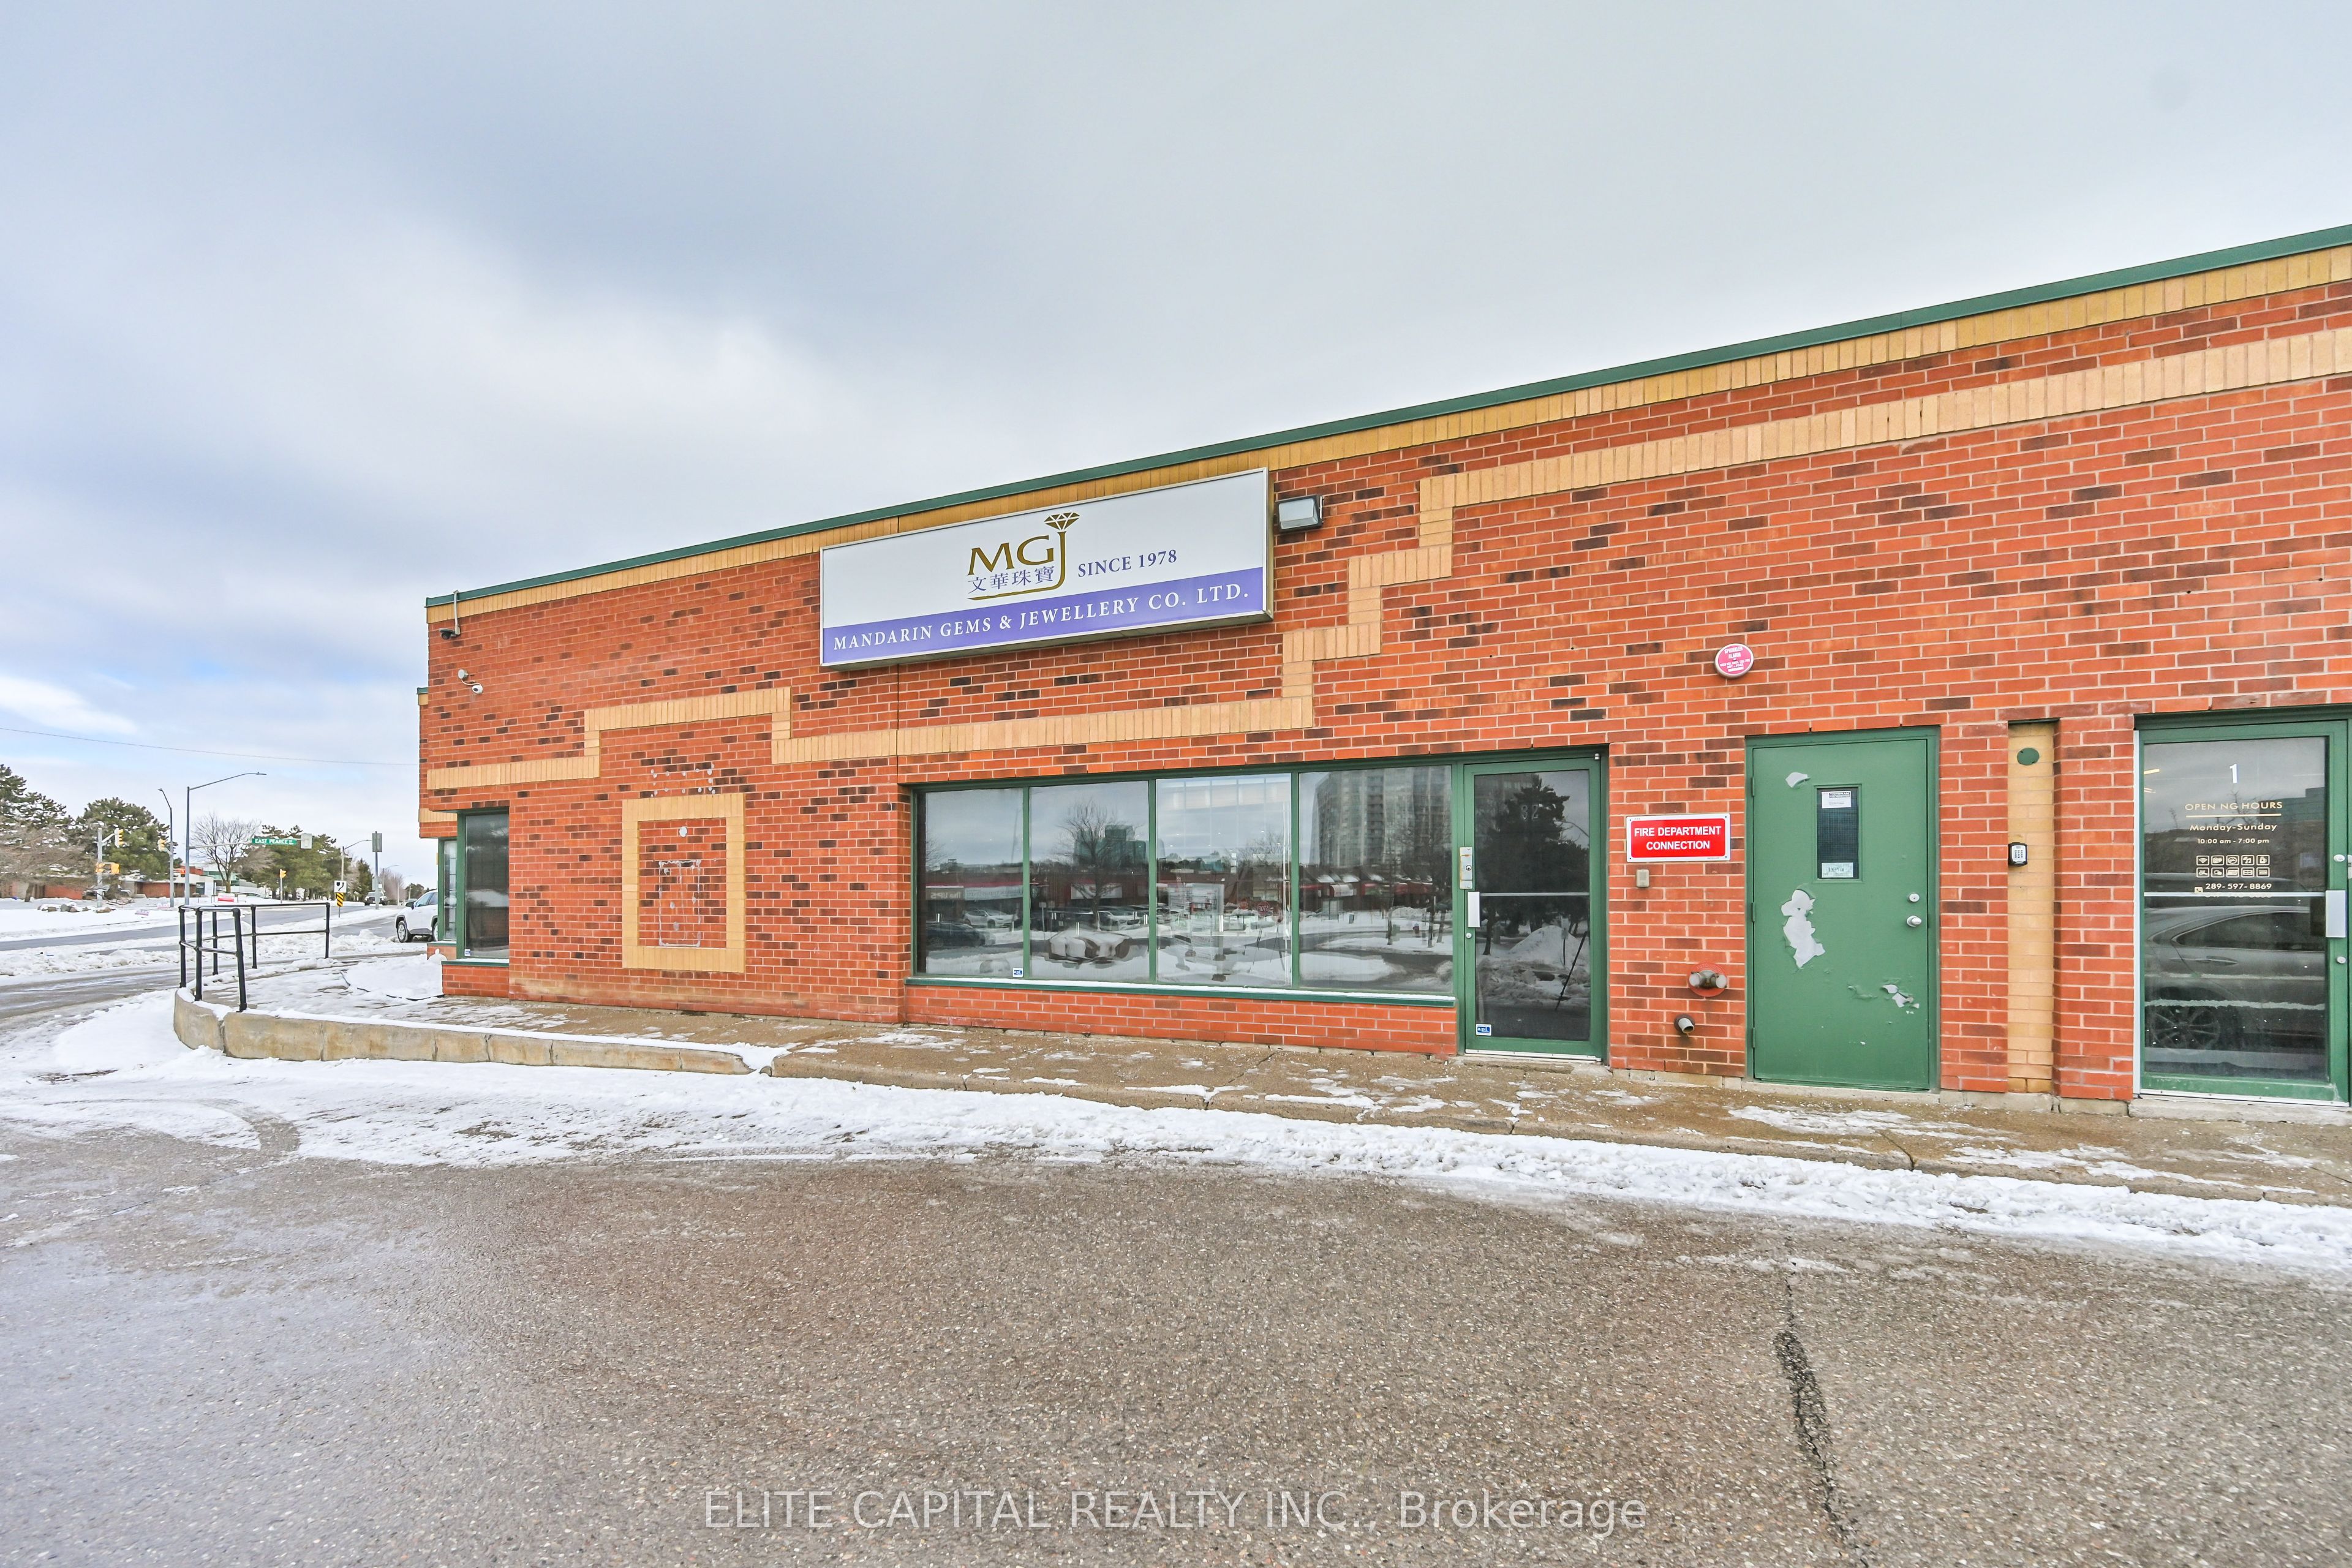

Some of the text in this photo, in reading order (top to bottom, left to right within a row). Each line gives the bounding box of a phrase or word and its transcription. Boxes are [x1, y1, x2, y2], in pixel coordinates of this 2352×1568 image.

[967, 530, 1067, 600] MGJ
[1078, 549, 1177, 577] SINCE 1978
[968, 566, 1055, 594] 文華珠寶
[833, 583, 1249, 650] MANDARIN GEMS & JEWELLERY CO. LTD.
[2230, 763, 2239, 783] 1
[2241, 801, 2283, 810] HOURS
[1634, 826, 1722, 837] FIRE DEPARTMENT
[2190, 823, 2277, 832] Monday-Sunday
[1646, 840, 1710, 850] CONNECTION
